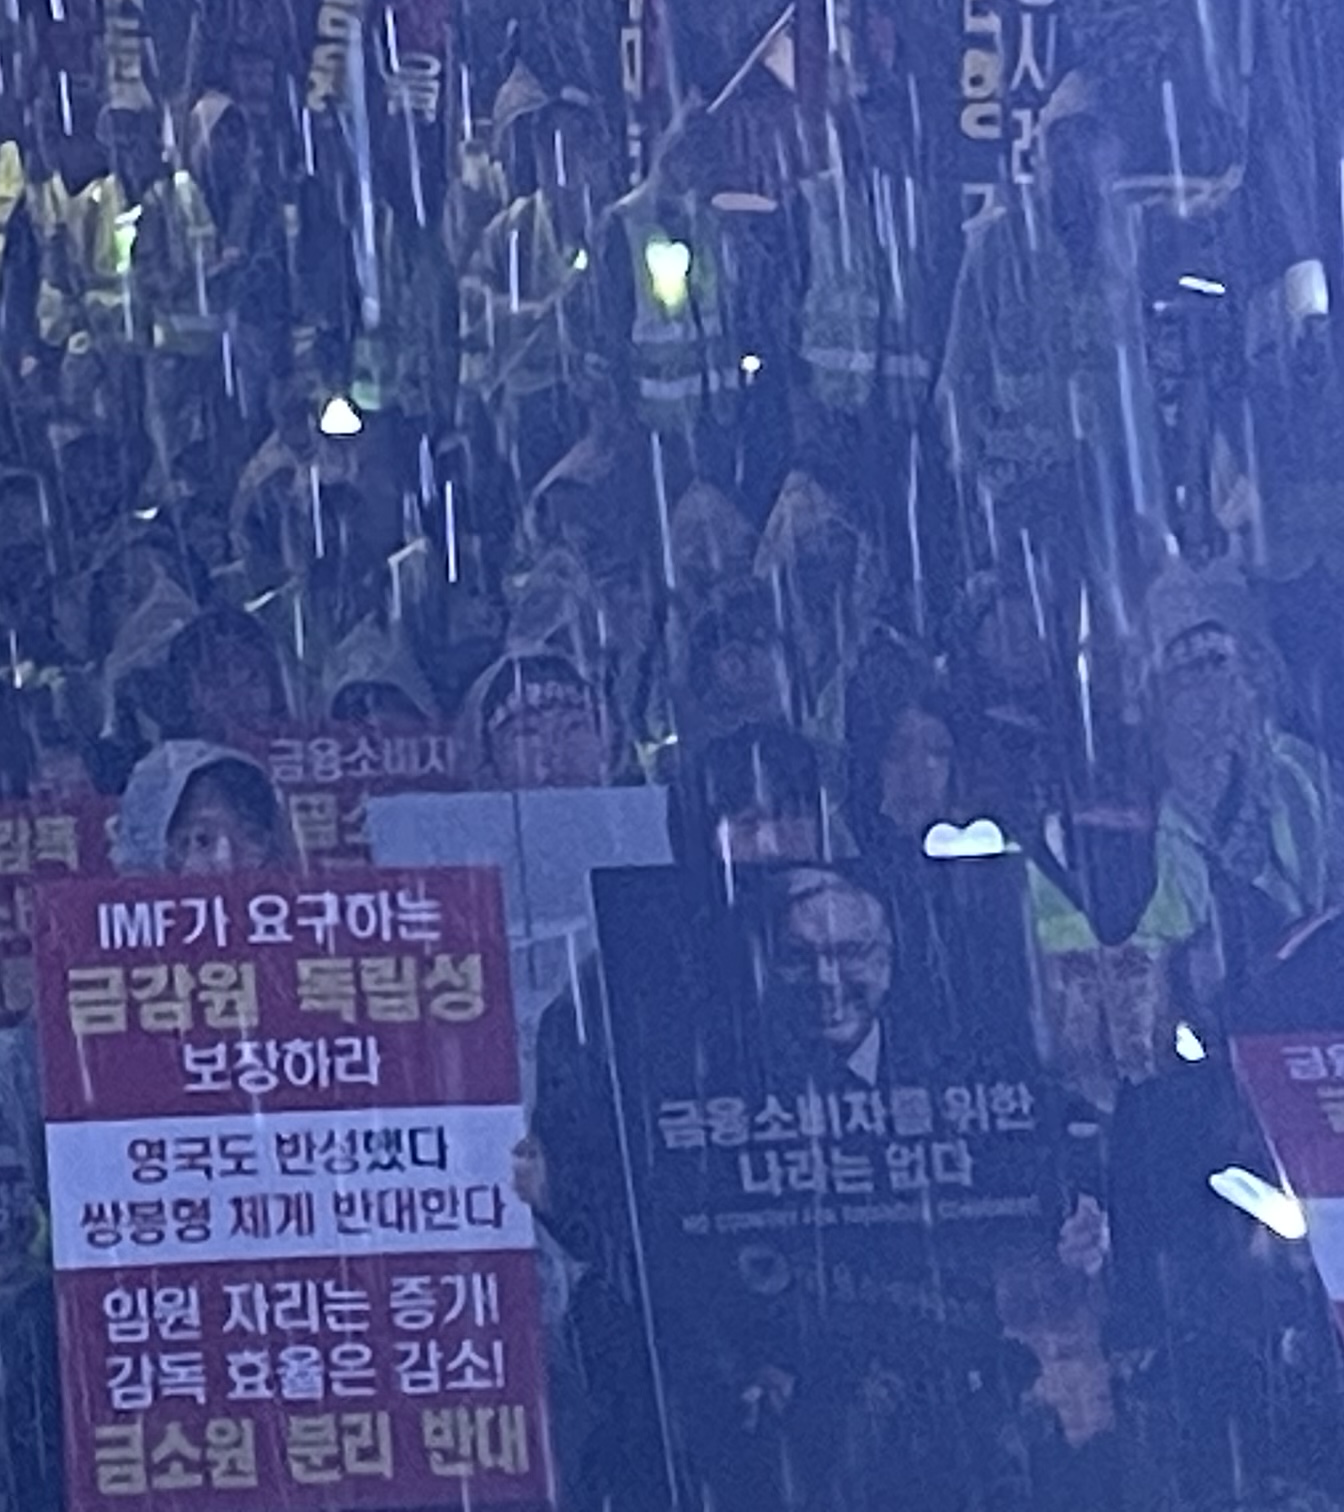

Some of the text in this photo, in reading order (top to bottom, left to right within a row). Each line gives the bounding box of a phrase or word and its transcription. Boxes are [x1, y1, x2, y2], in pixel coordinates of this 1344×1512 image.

[99, 894, 229, 951] IMF가
[249, 890, 443, 947] 요구하는
[67, 954, 486, 1035] 금감원 독립성
[184, 1037, 381, 1094] 보장하라
[658, 1081, 1035, 1149] 금융소비자를 위한
[127, 1126, 450, 1183] 영국도 반성했다
[738, 1138, 974, 1197] 나라는 없다
[333, 1182, 506, 1235] 반대한다
[104, 1286, 202, 1344] 임원
[223, 1280, 371, 1335] 자리는
[105, 1353, 206, 1412] 감독
[227, 1343, 376, 1403] 효율은
[95, 1404, 529, 1496] 금소원 분리 반대
